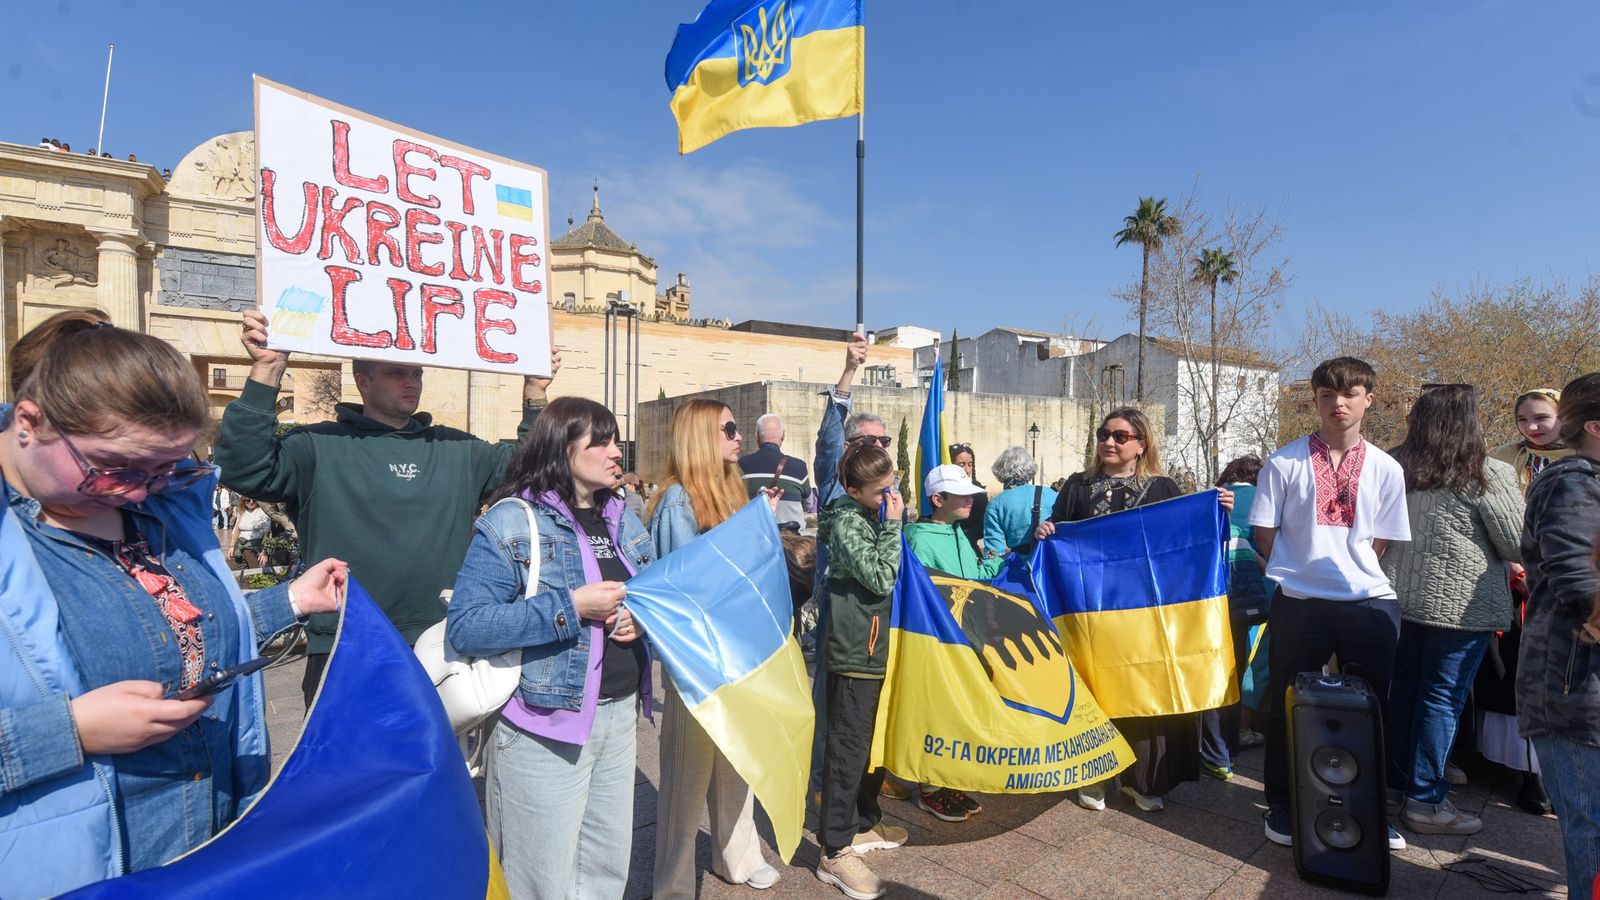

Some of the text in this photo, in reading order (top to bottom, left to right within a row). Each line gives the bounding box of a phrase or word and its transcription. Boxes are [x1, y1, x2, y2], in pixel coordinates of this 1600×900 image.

[330, 119, 491, 216] LET
[260, 167, 543, 294] UKREINE
[324, 265, 519, 364] LIFE
[388, 463, 420, 474] N.Y.C.
[923, 734, 971, 762] 92-ГА
[975, 745, 1041, 766] ОКРЕМА
[1005, 750, 1119, 790] AMIGOS DE CORDOBA
